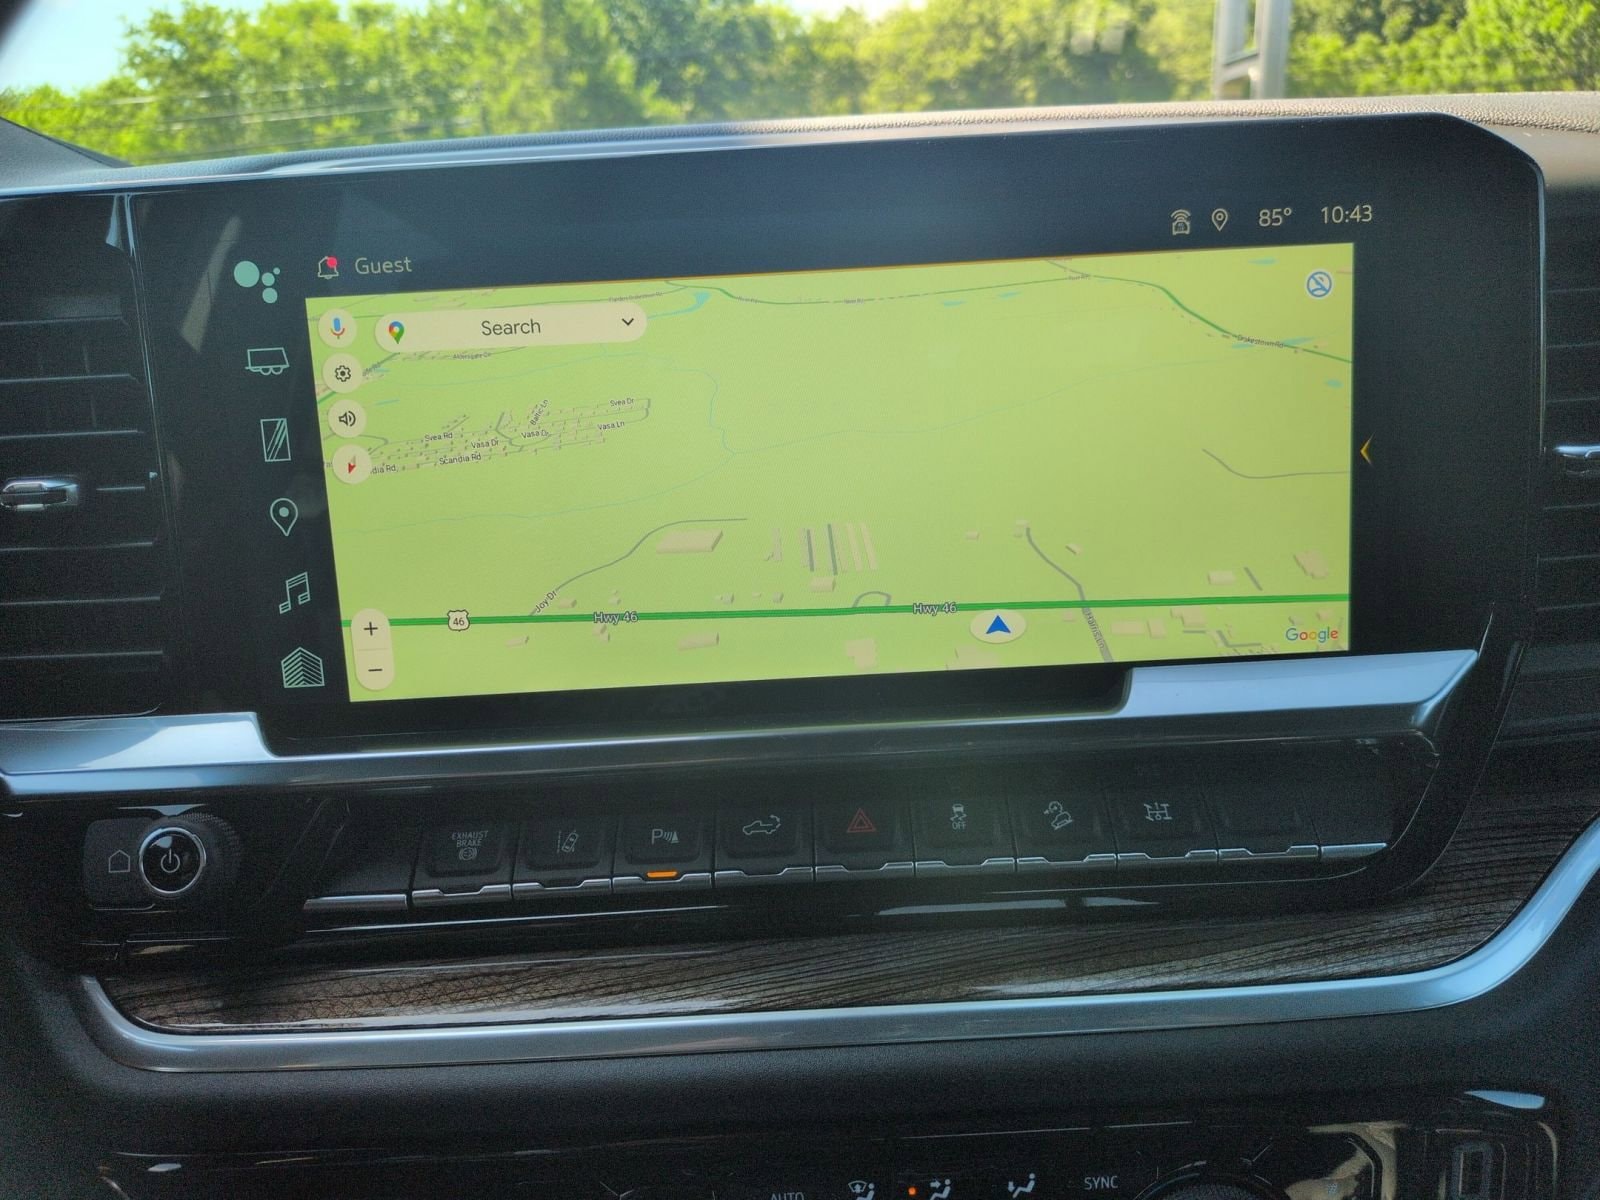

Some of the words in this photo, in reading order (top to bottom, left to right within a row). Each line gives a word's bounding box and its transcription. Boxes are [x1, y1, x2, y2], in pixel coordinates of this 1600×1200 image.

[1258, 207, 1293, 227] 85°
[1321, 204, 1374, 224] 10:43
[354, 256, 412, 276] Guest
[480, 318, 542, 337] Search
[609, 399, 626, 407] Svea
[626, 397, 635, 405] Dr
[530, 407, 543, 426] Baltic
[540, 399, 549, 409] Ln
[597, 422, 615, 431] Vasa
[616, 420, 625, 429] Ln
[424, 433, 442, 442] Svea
[442, 432, 453, 440] Rd
[521, 429, 540, 439] Vasa
[471, 440, 490, 449] Vasa
[491, 438, 499, 447] Dr
[439, 455, 470, 465] Scandia
[471, 453, 482, 462] Rd
[535, 599, 549, 613] Joy
[912, 602, 939, 616] Hwy
[942, 601, 957, 614] 46
[453, 617, 465, 626] 46
[593, 611, 619, 625] Hwy
[622, 610, 639, 623] 46
[1285, 626, 1339, 643] Google
[952, 821, 967, 830] OFF
[452, 830, 489, 841] EXHAUST
[457, 839, 482, 848] BRAKE
[1084, 1175, 1119, 1190] SYNC
[770, 1191, 805, 1200] AUTO
